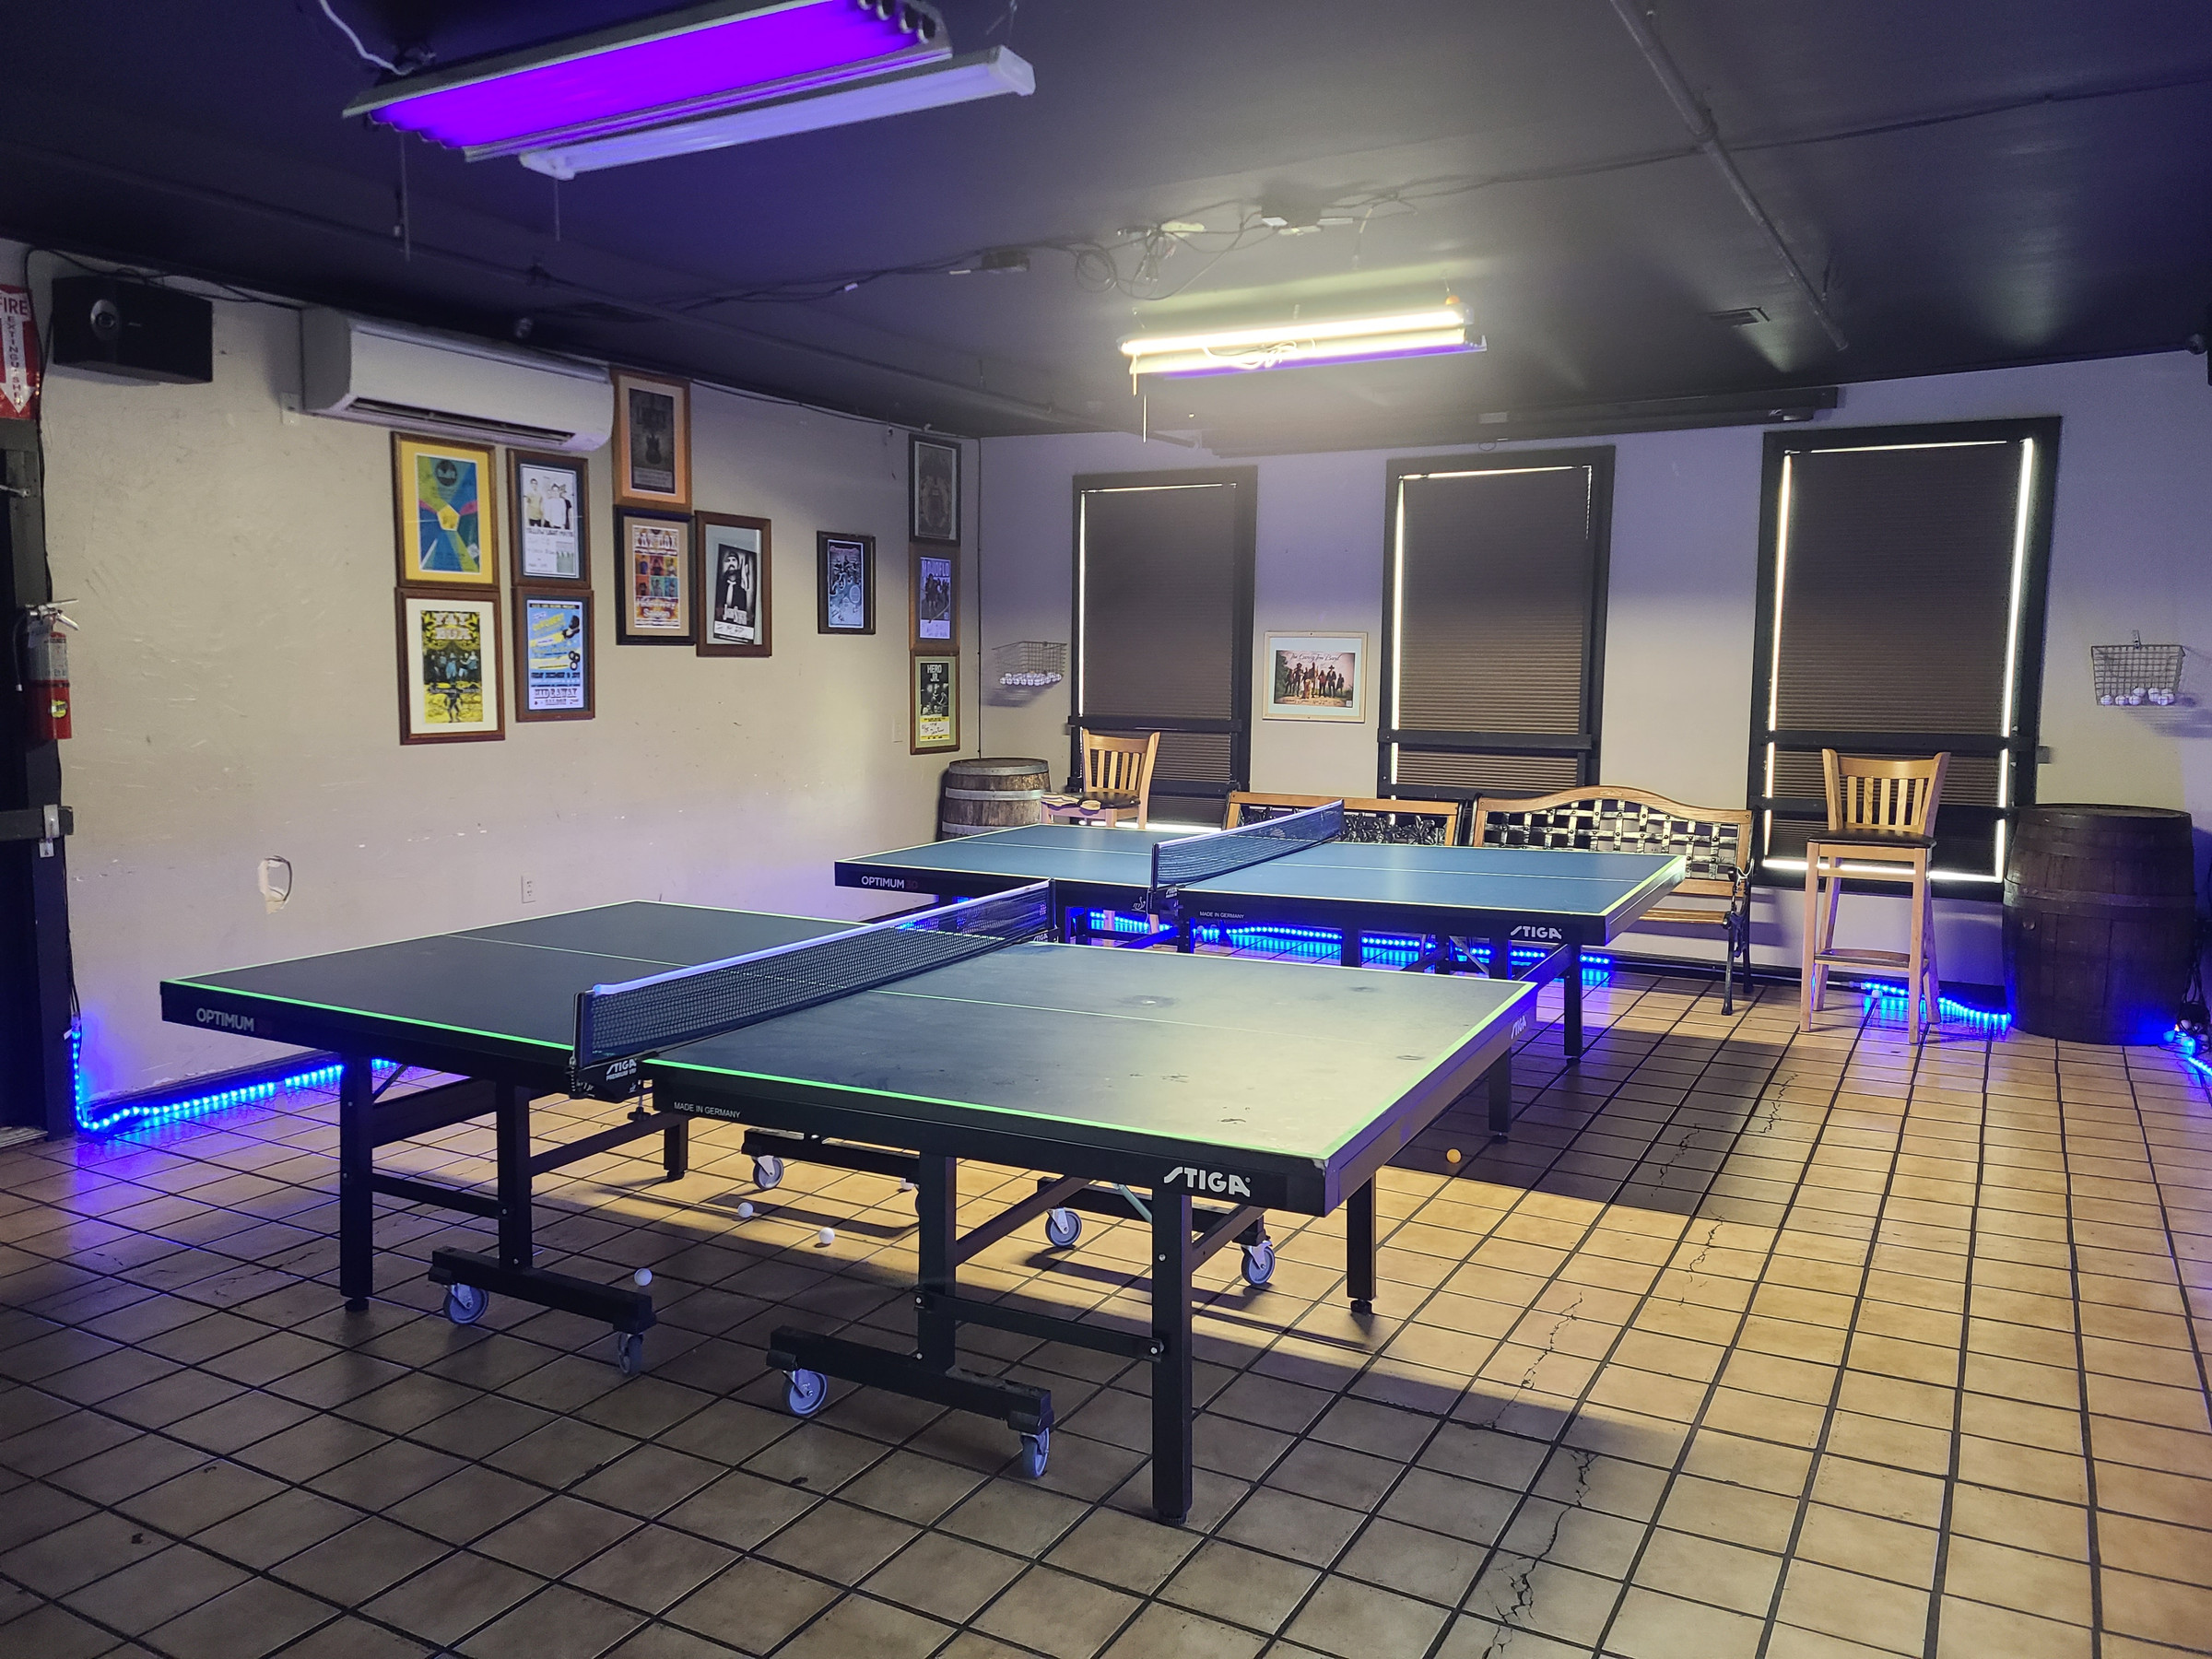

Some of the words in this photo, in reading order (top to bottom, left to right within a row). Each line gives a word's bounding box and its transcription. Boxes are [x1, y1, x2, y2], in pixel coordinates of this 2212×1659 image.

[926, 665, 942, 674] HERO
[862, 876, 905, 888] OPTIMUM
[1511, 925, 1562, 940] STIGA
[196, 1007, 254, 1032] OPTIMUM
[606, 1058, 637, 1075] STIGA
[674, 1101, 694, 1112] MADE
[695, 1105, 703, 1113] IN
[704, 1106, 740, 1119] GERMANY
[1164, 1166, 1251, 1197] STIGA
